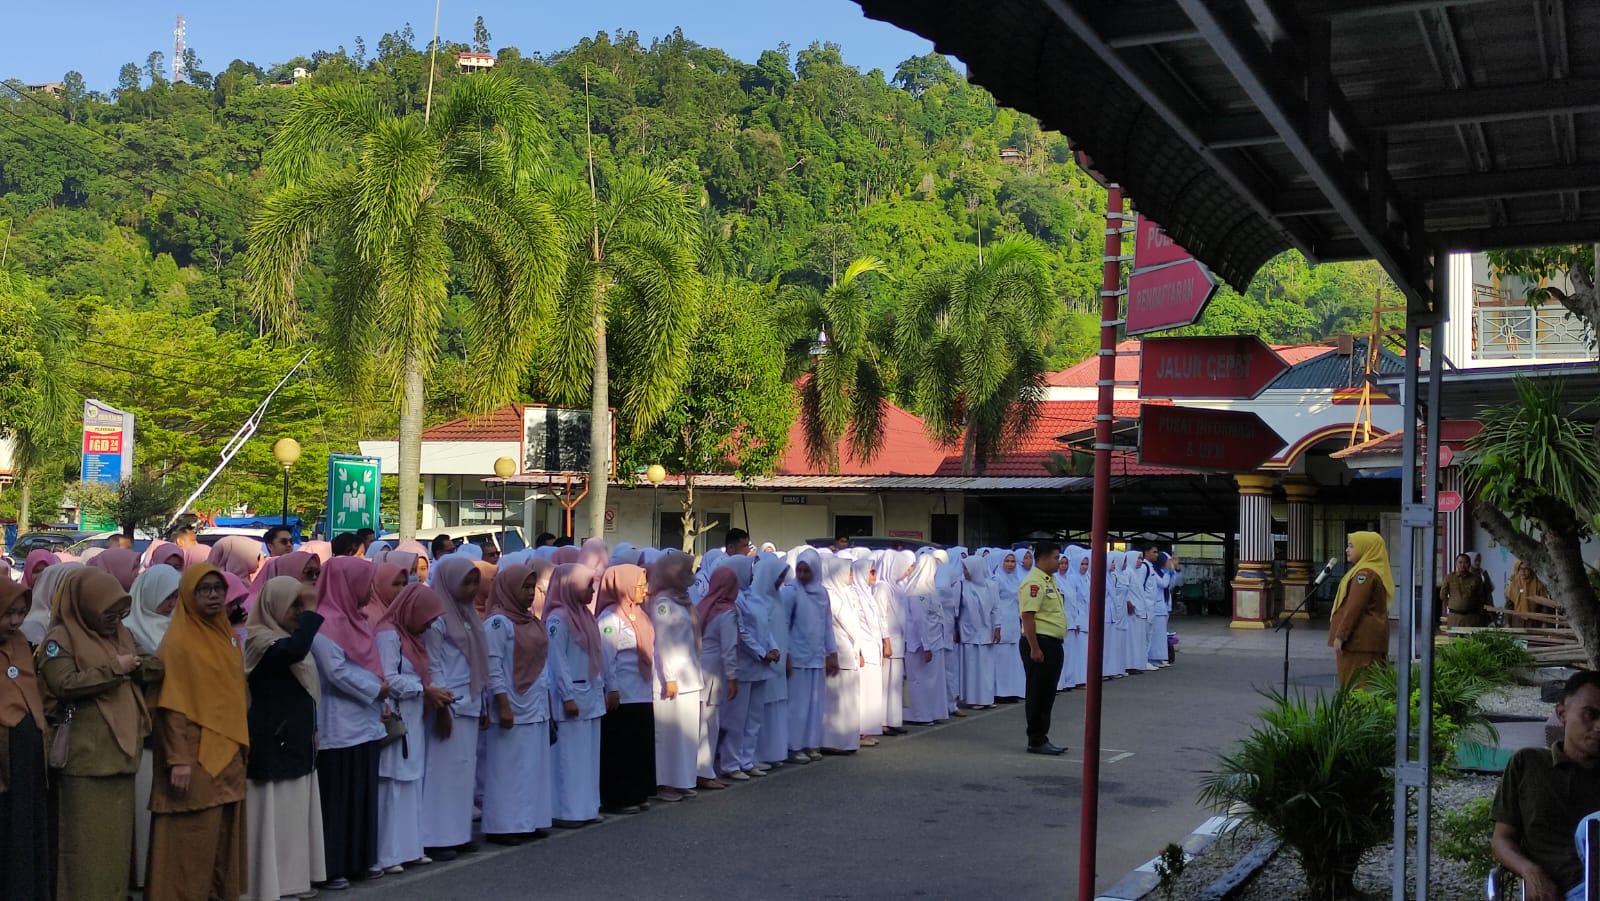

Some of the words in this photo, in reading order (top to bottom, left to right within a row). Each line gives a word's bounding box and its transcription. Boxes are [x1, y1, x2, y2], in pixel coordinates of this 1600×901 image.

[1156, 354, 1203, 378] JALUR
[1206, 353, 1253, 379] CEPAT
[89, 439, 109, 451] IGD
